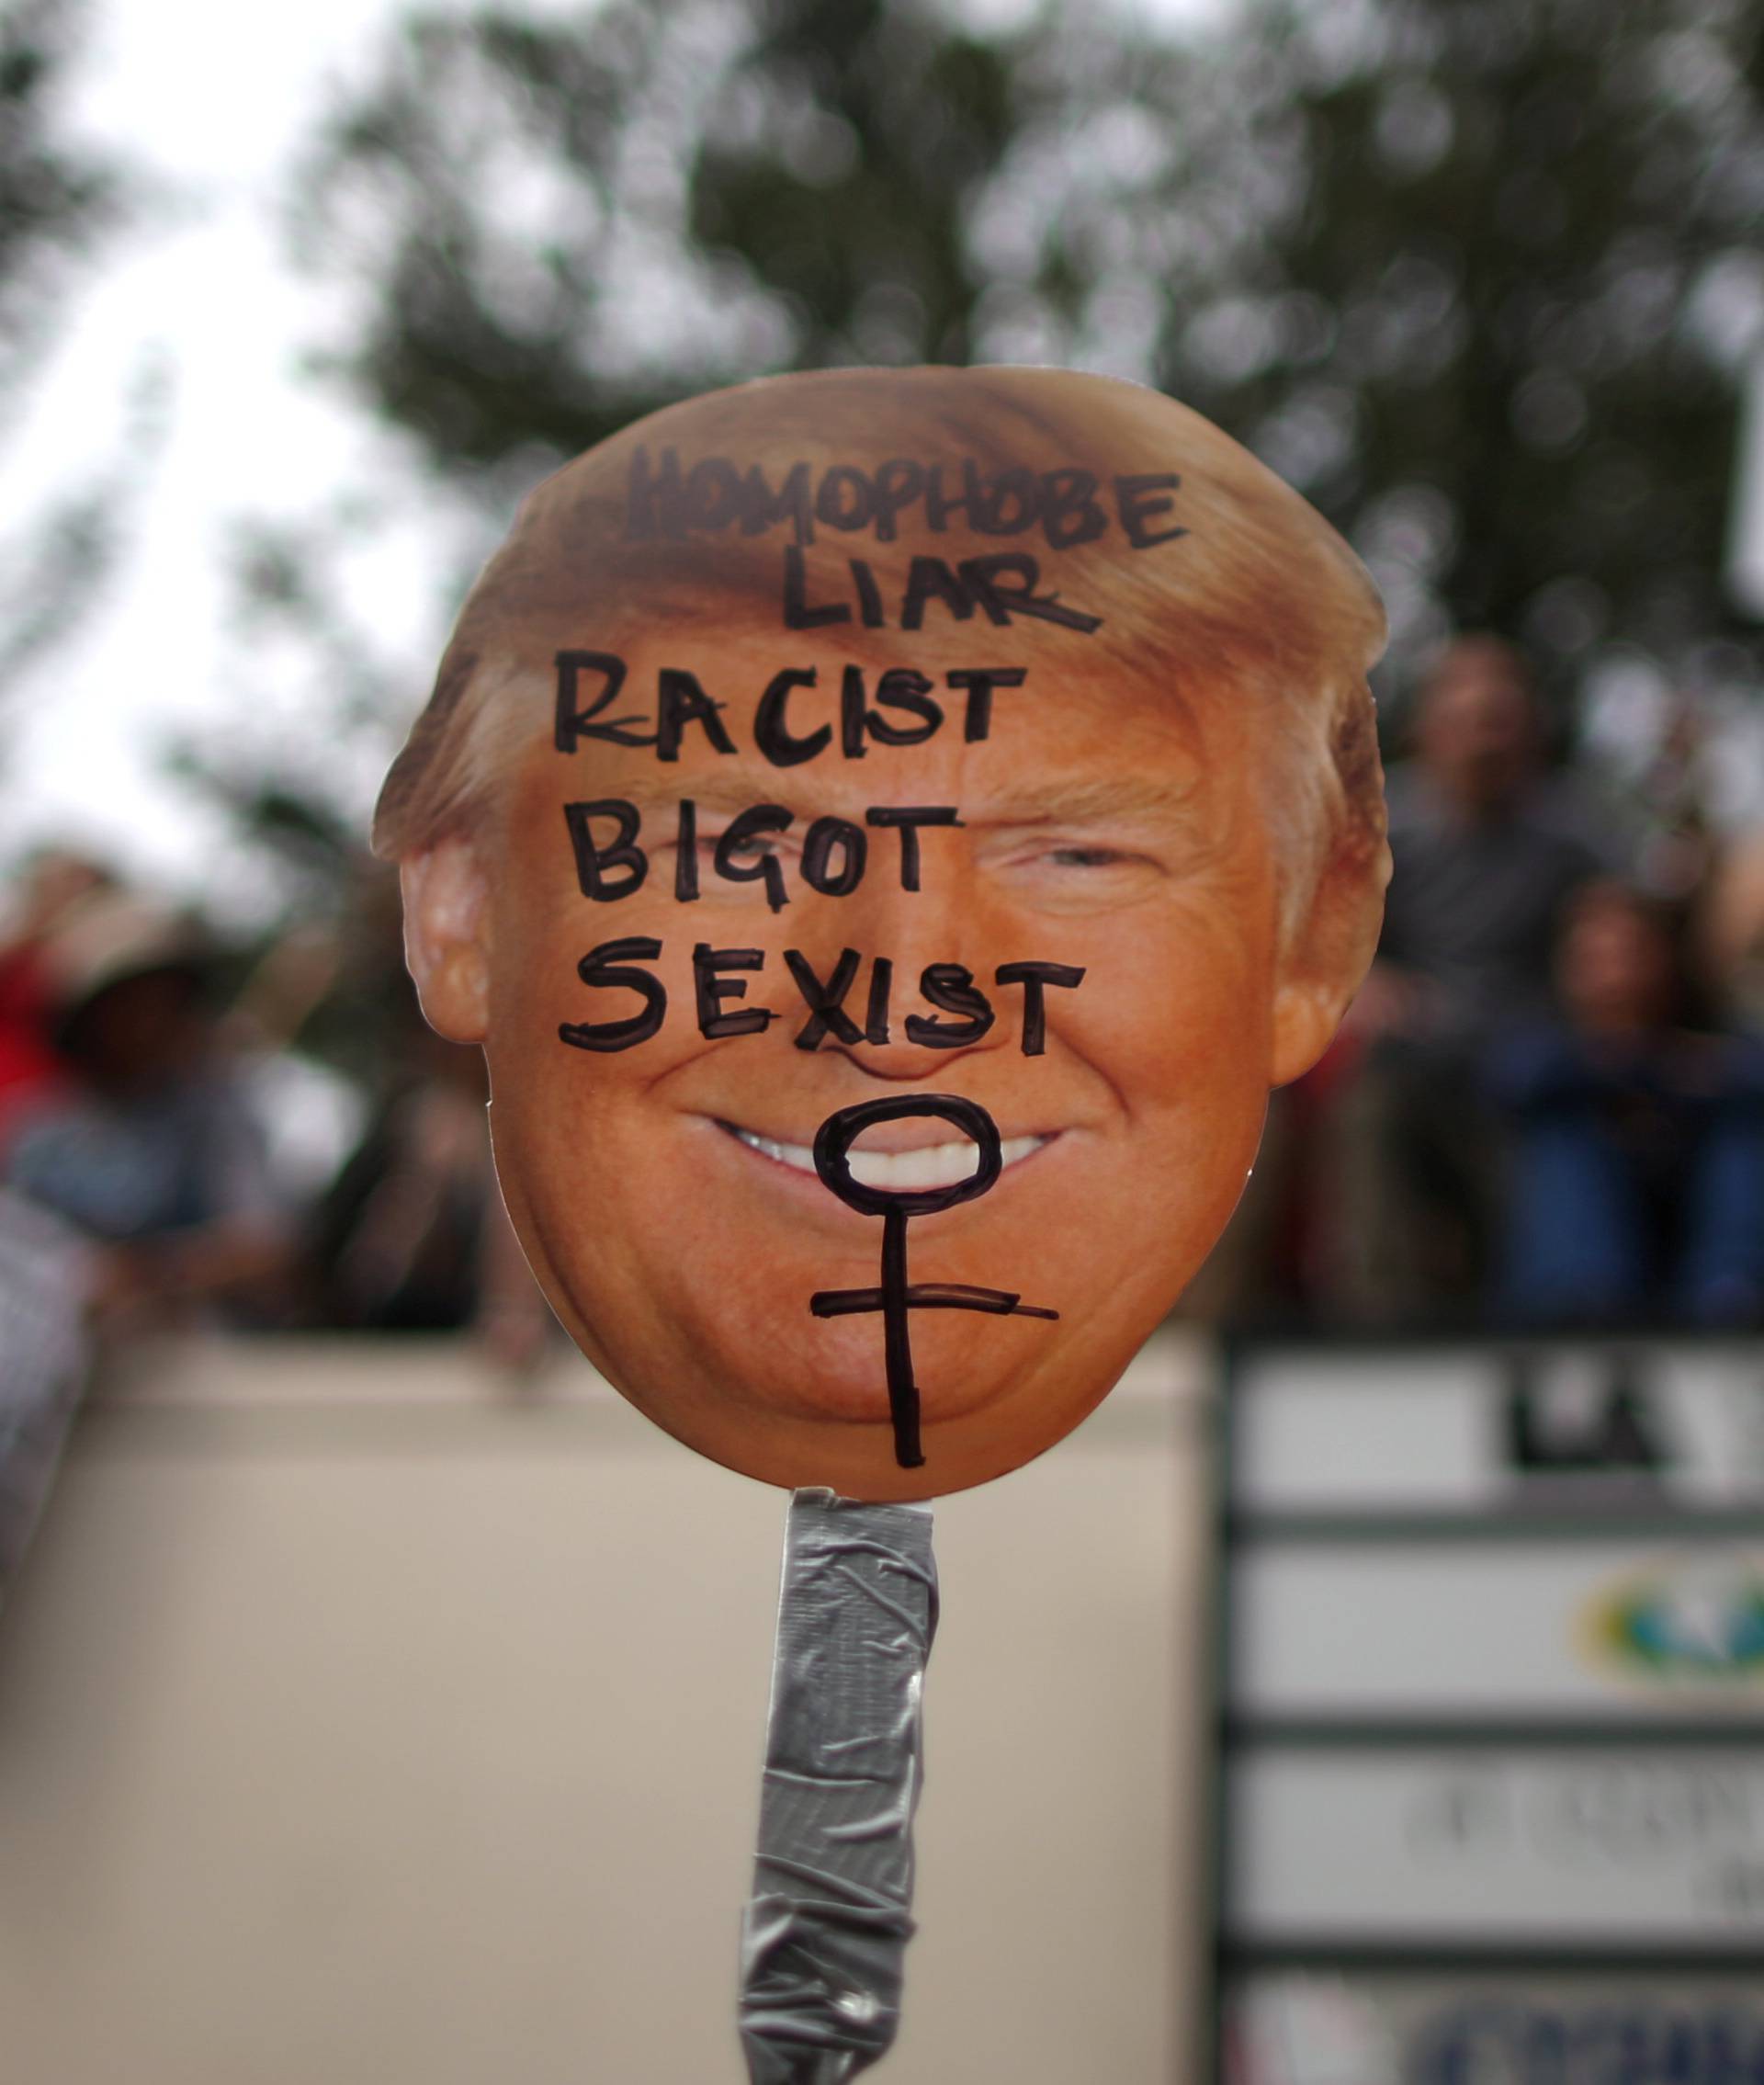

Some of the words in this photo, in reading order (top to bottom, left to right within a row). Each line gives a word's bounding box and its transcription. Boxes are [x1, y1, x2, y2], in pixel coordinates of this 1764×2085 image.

[623, 443, 1190, 550] HOMOPHOBE
[783, 545, 1105, 634] LIAR
[554, 649, 1027, 767] RACIST
[563, 798, 967, 913] BIGOT
[559, 935, 1087, 1056] SEXIST
